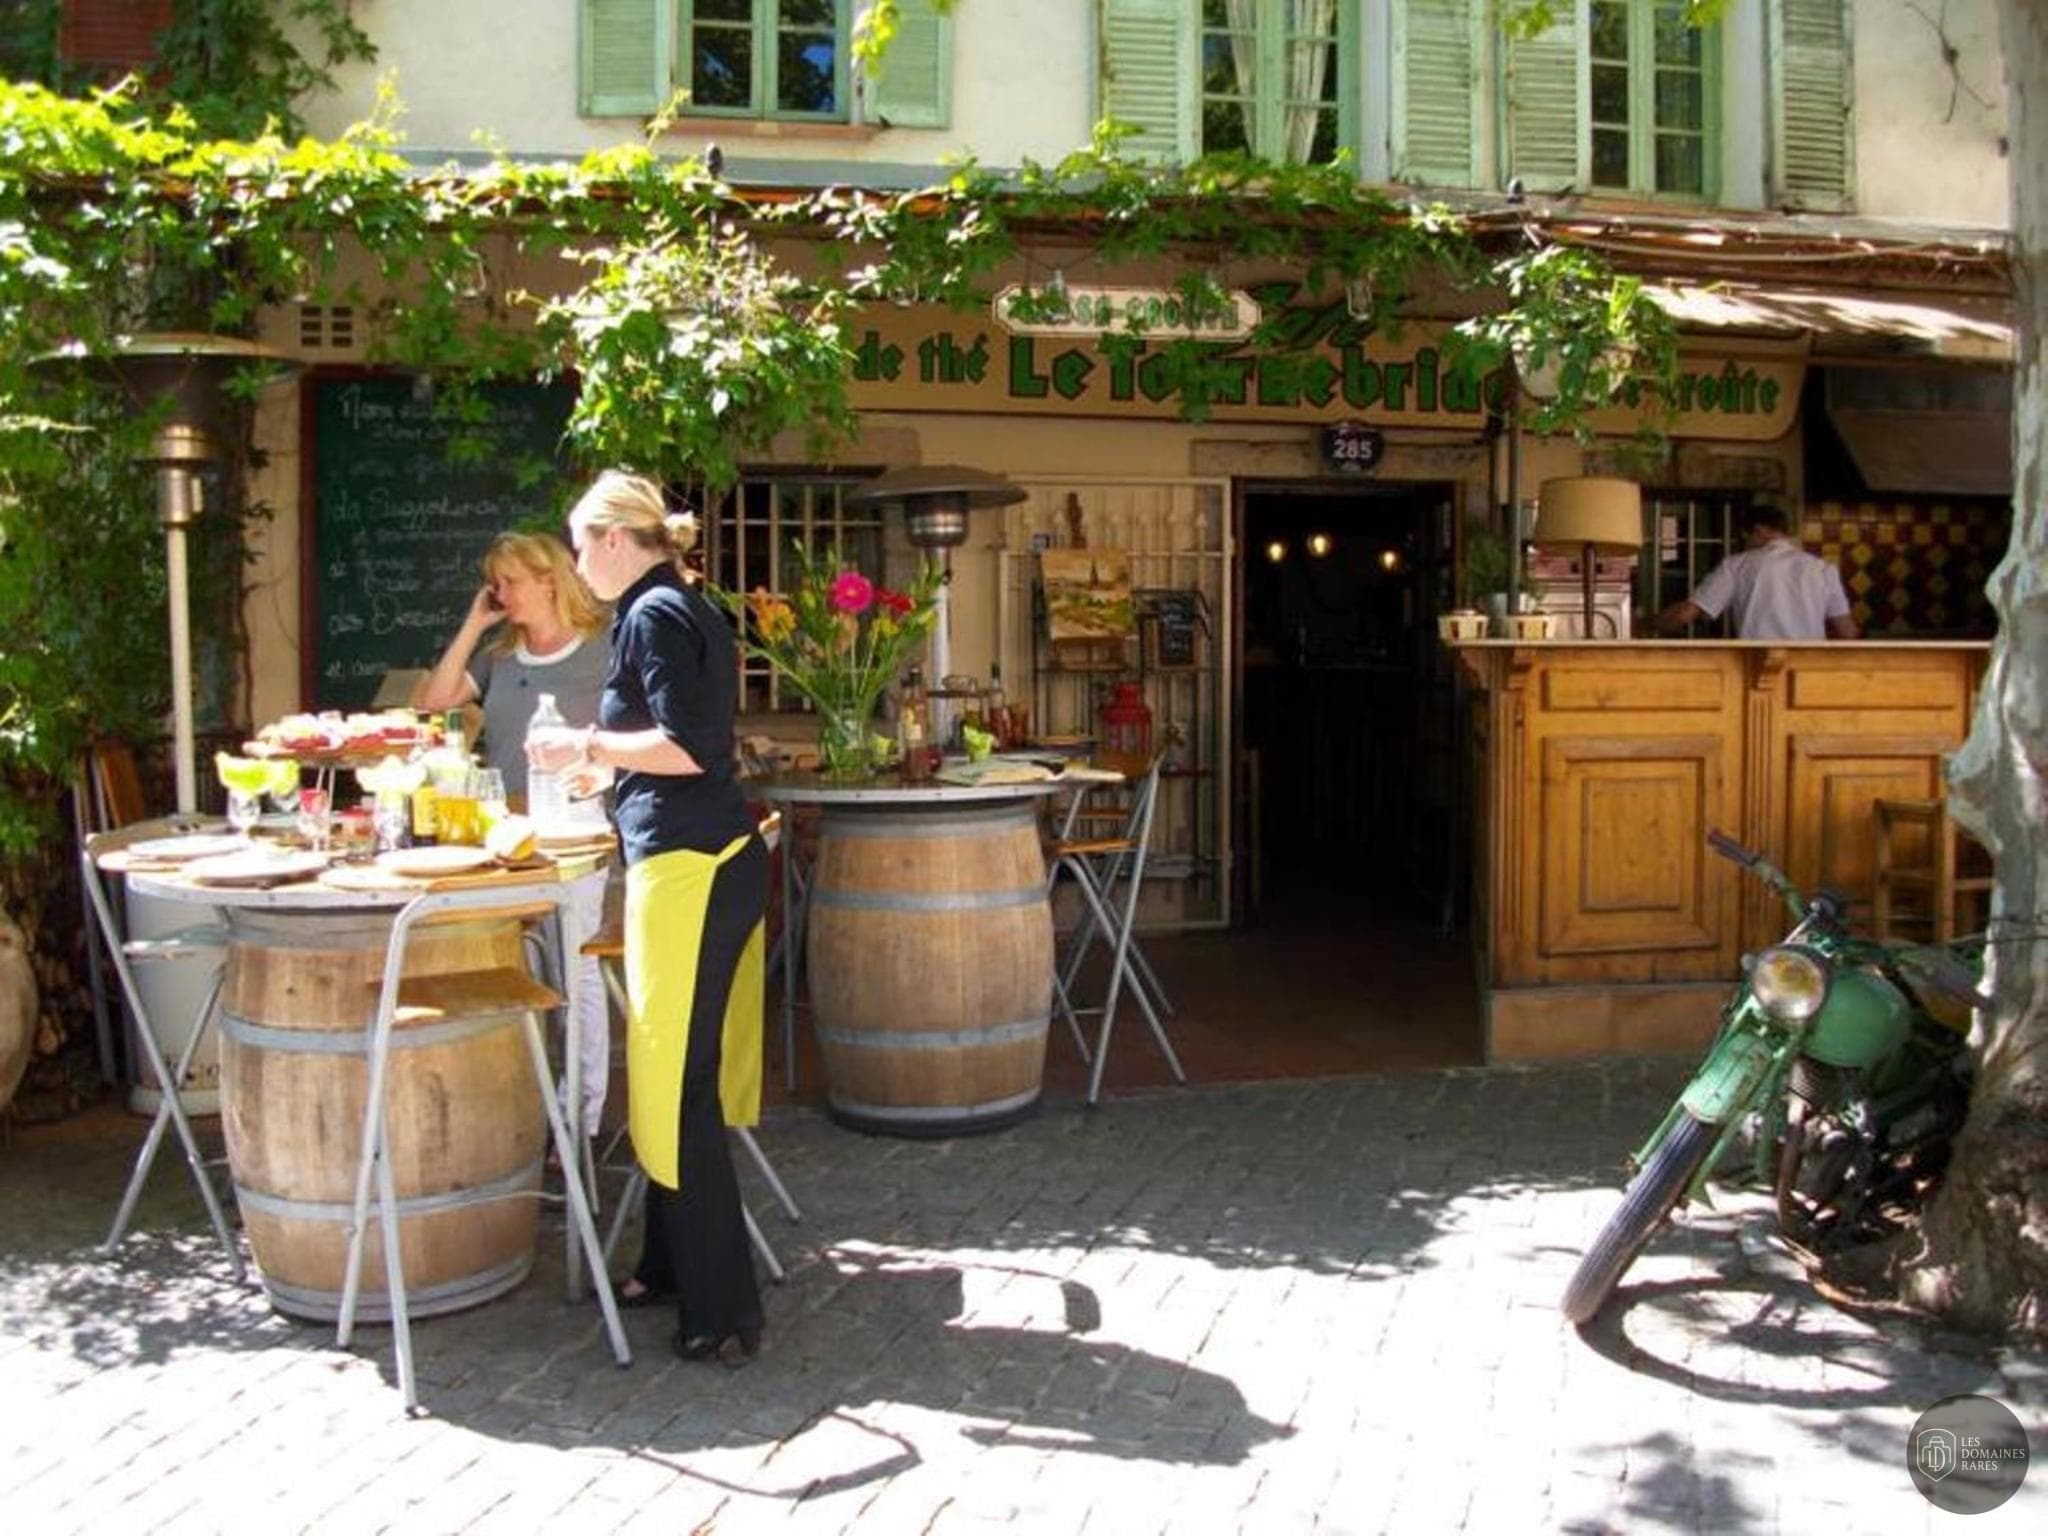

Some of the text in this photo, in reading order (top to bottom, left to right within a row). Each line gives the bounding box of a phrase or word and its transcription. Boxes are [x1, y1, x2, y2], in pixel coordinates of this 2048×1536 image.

[853, 330, 989, 384] de thé
[1009, 335, 1096, 401] Le
[1332, 438, 1373, 459] 285
